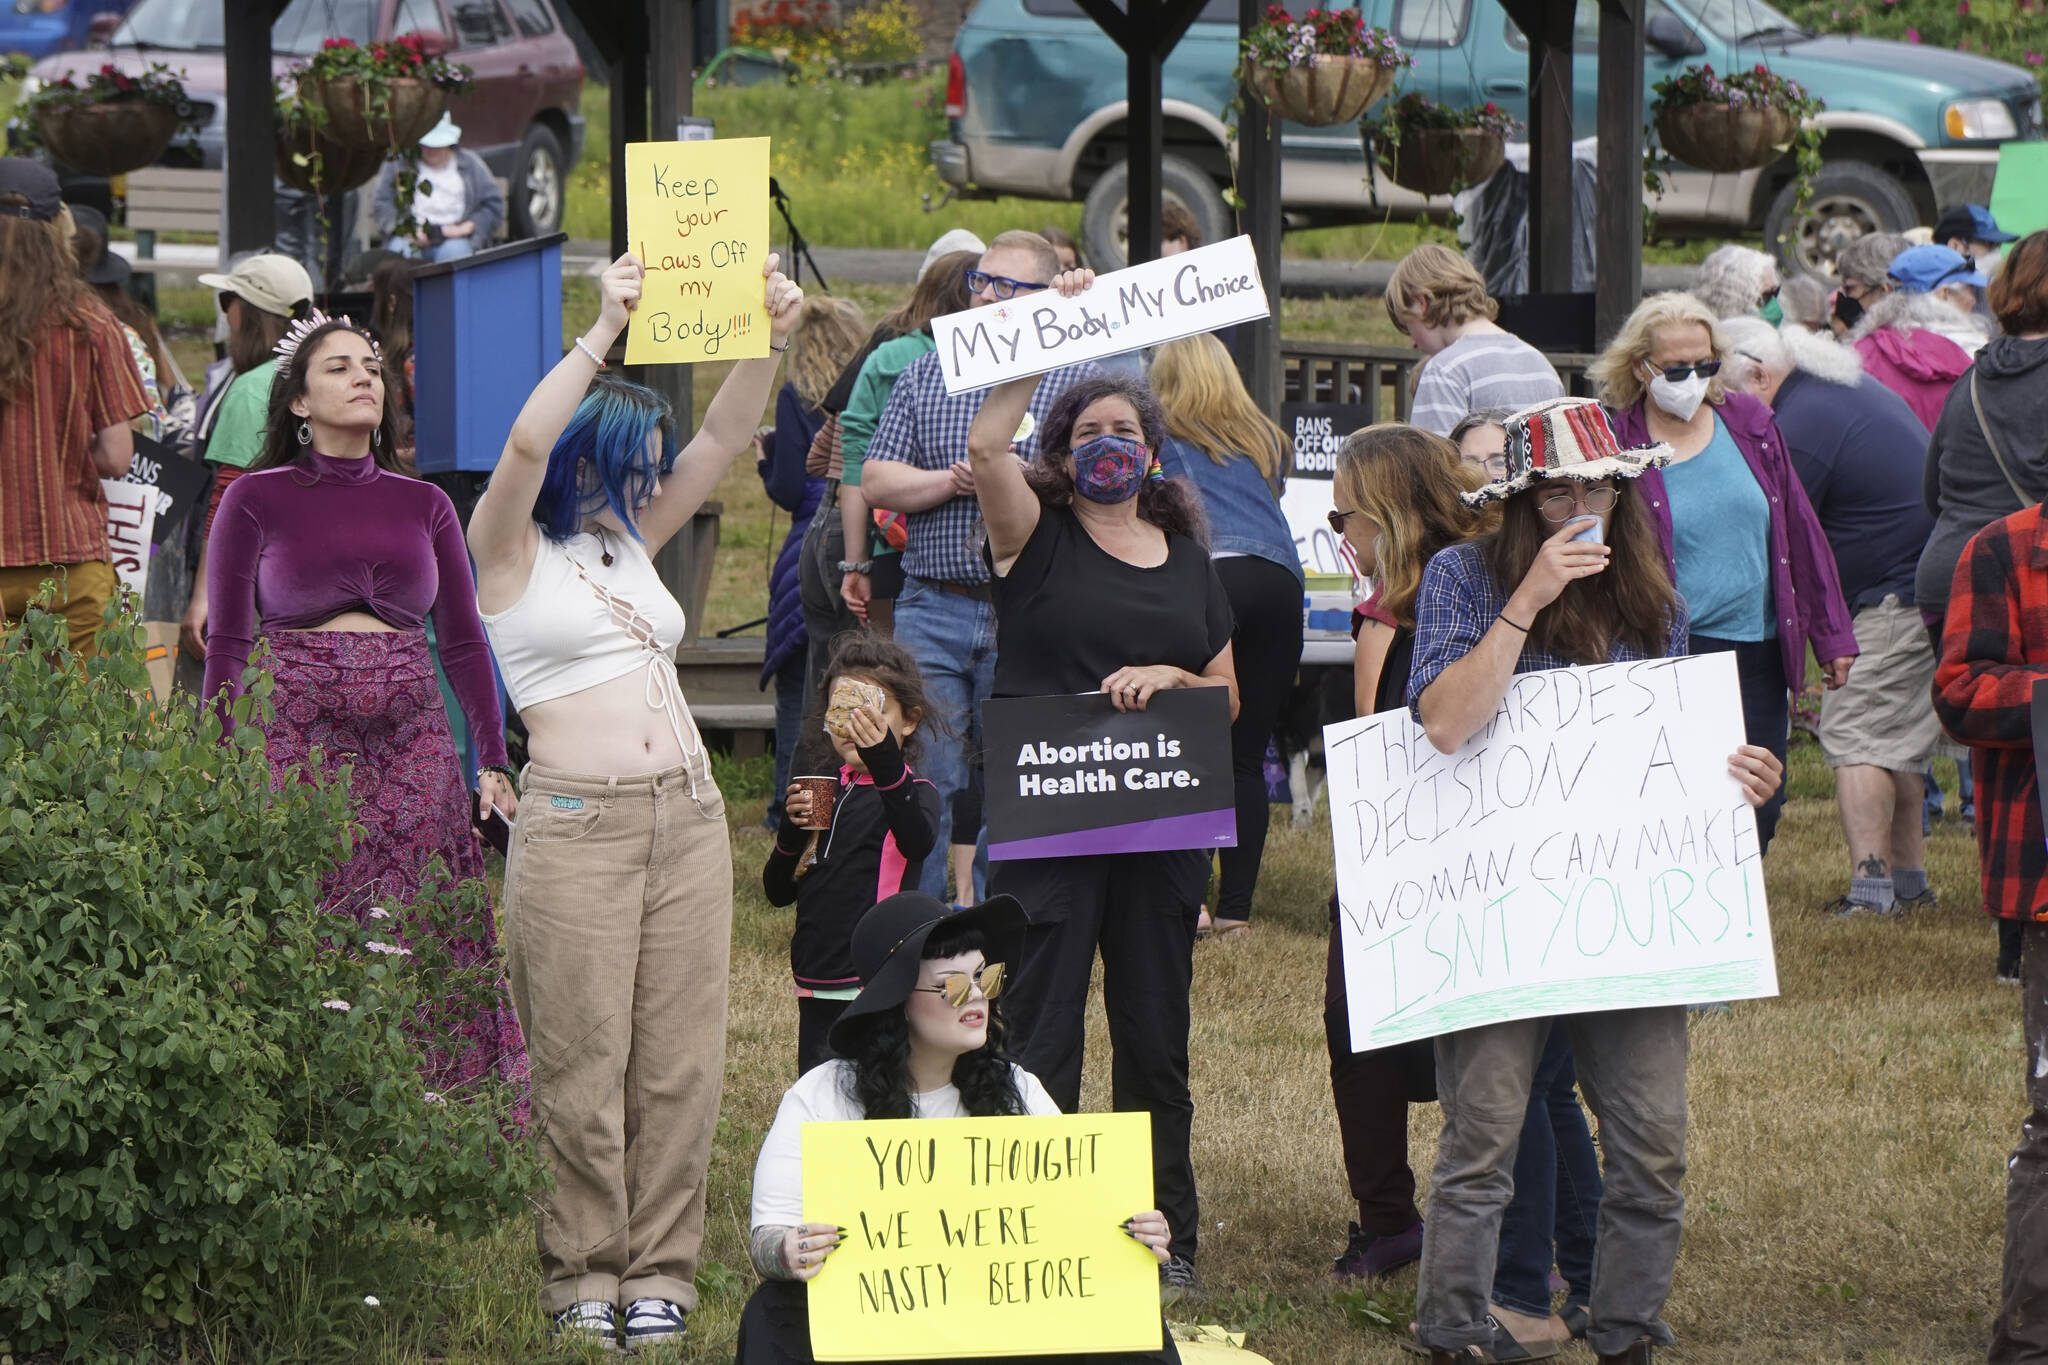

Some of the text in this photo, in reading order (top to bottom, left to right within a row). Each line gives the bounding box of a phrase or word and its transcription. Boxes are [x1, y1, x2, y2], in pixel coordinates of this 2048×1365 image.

[653, 163, 719, 205] Keep
[675, 208, 729, 238] your
[640, 240, 748, 271] Laws Off
[679, 280, 713, 298] my
[952, 321, 1021, 377] My
[1118, 282, 1164, 326] My
[1173, 264, 1255, 306] Choice
[1295, 416, 1333, 435] BANS
[1321, 435, 1345, 454] OU
[130, 452, 163, 484] ANS
[1331, 655, 1701, 790] THE ARDEST
[1016, 733, 1182, 766] Abortion is
[1019, 767, 1201, 797] Health Care.
[1348, 725, 1688, 865] DECISION A
[1340, 803, 1762, 937] WOMAN CAN MAKE
[1539, 864, 1754, 969] YOURS!
[865, 1132, 1103, 1191] YOU THOUGHT
[859, 1210, 914, 1251] WE
[938, 1205, 1040, 1248] WERE
[858, 1255, 1097, 1315] NASTY BEFORE
